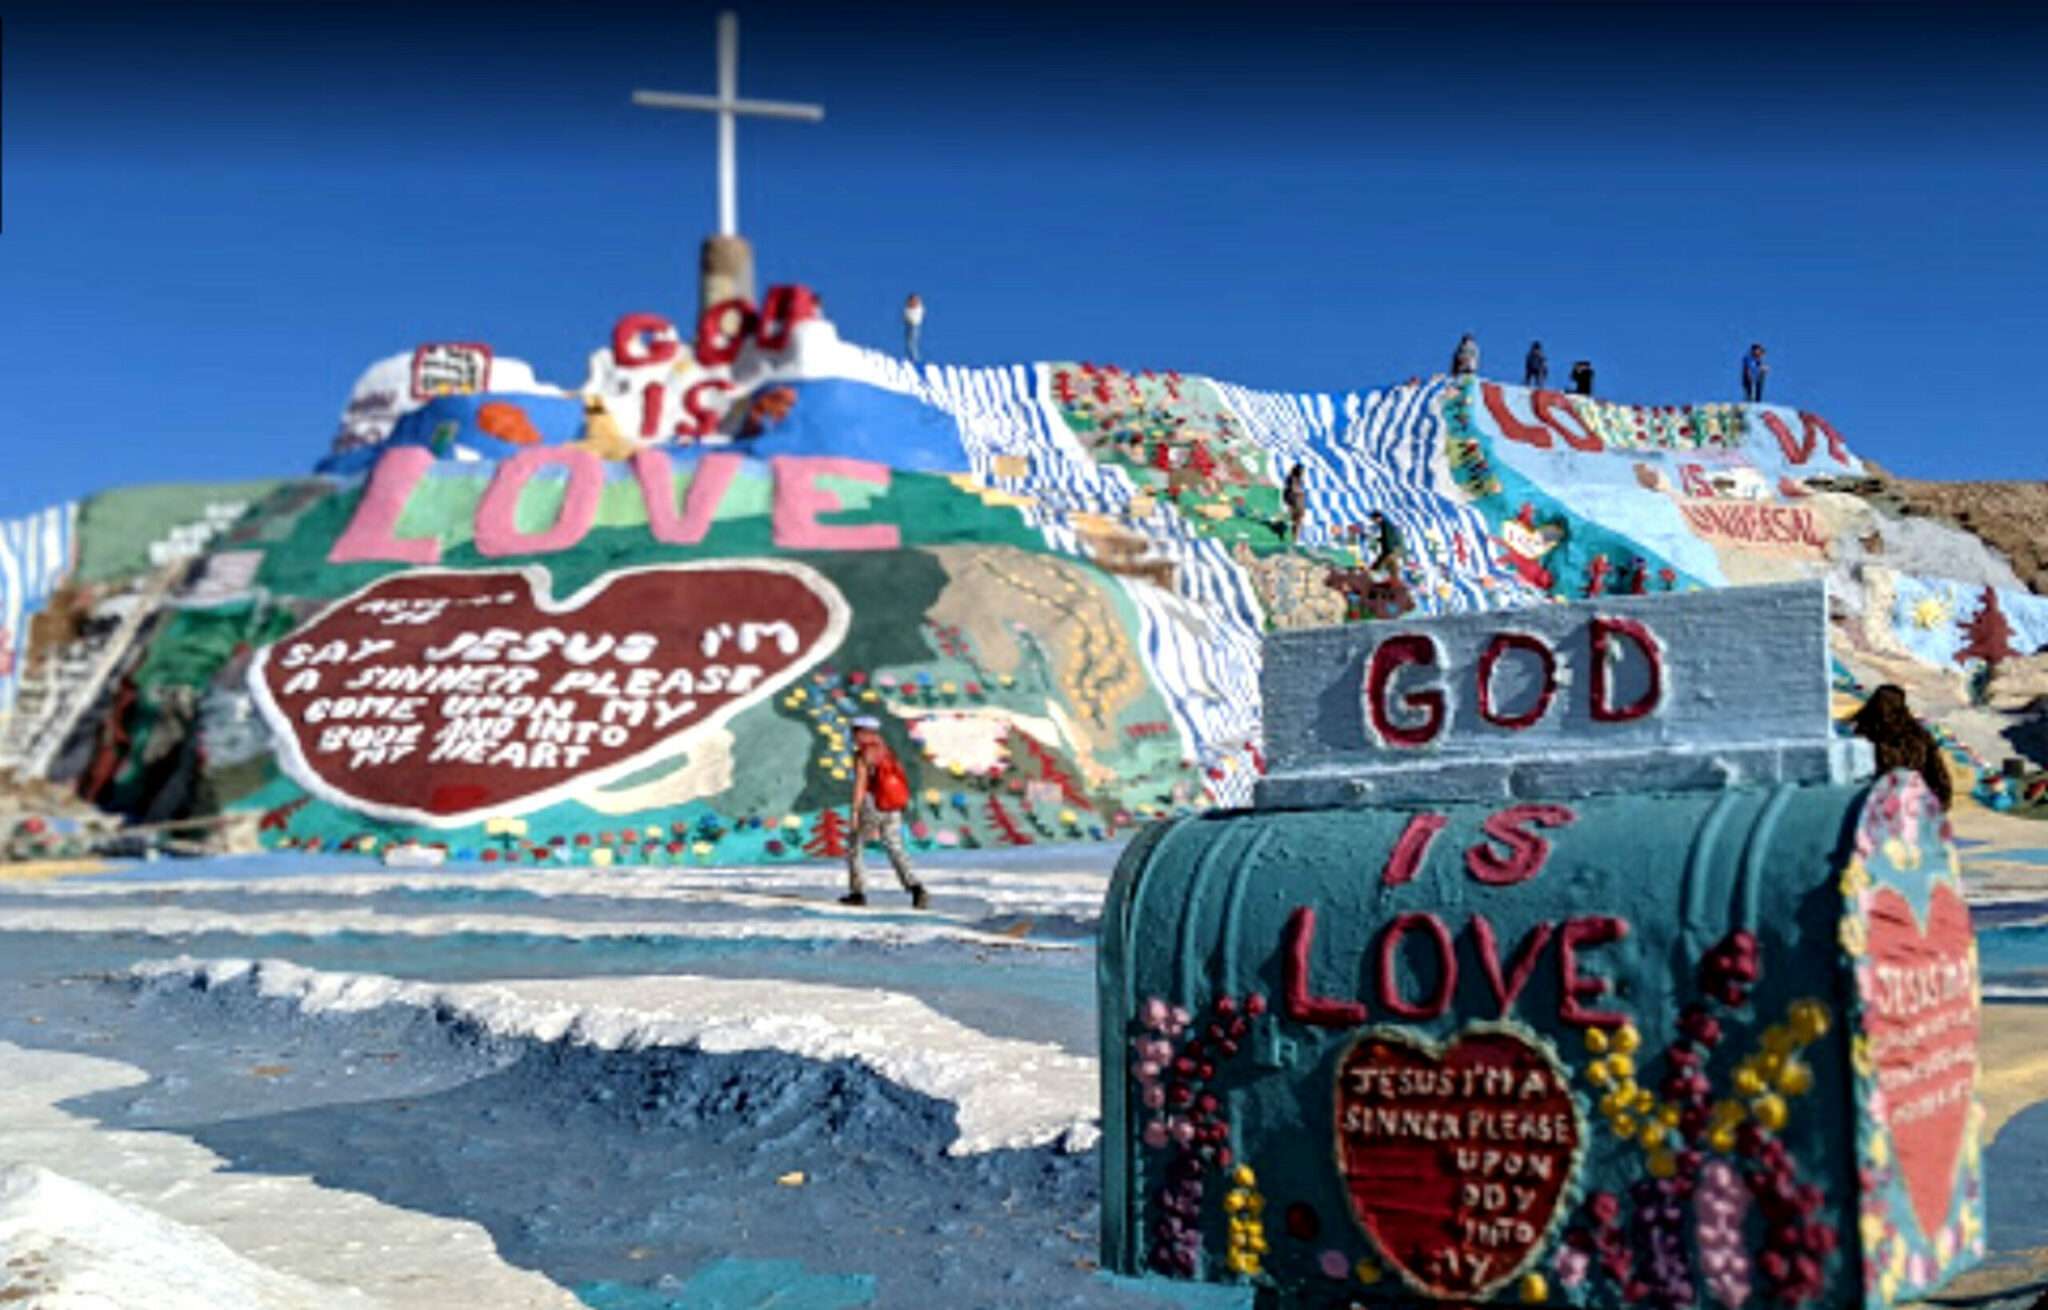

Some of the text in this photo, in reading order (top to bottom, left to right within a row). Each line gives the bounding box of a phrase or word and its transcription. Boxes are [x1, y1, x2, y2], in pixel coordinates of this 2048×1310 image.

[640, 378, 736, 437] IS
[327, 446, 900, 564] LOVE
[281, 620, 800, 668] SAY JESUS I'M
[282, 664, 764, 695] A SINNER PLEASE
[1362, 616, 1668, 750] GOD
[304, 696, 698, 729] COME UPON MY
[525, 717, 628, 747] INTO
[428, 738, 590, 768] HEART
[1382, 804, 1578, 887] IS
[1286, 906, 1632, 1028] LOVE
[1350, 1063, 1548, 1099] JESUS I'M A
[1468, 1108, 1569, 1144] PLEASE
[1456, 1149, 1552, 1179] UPON
